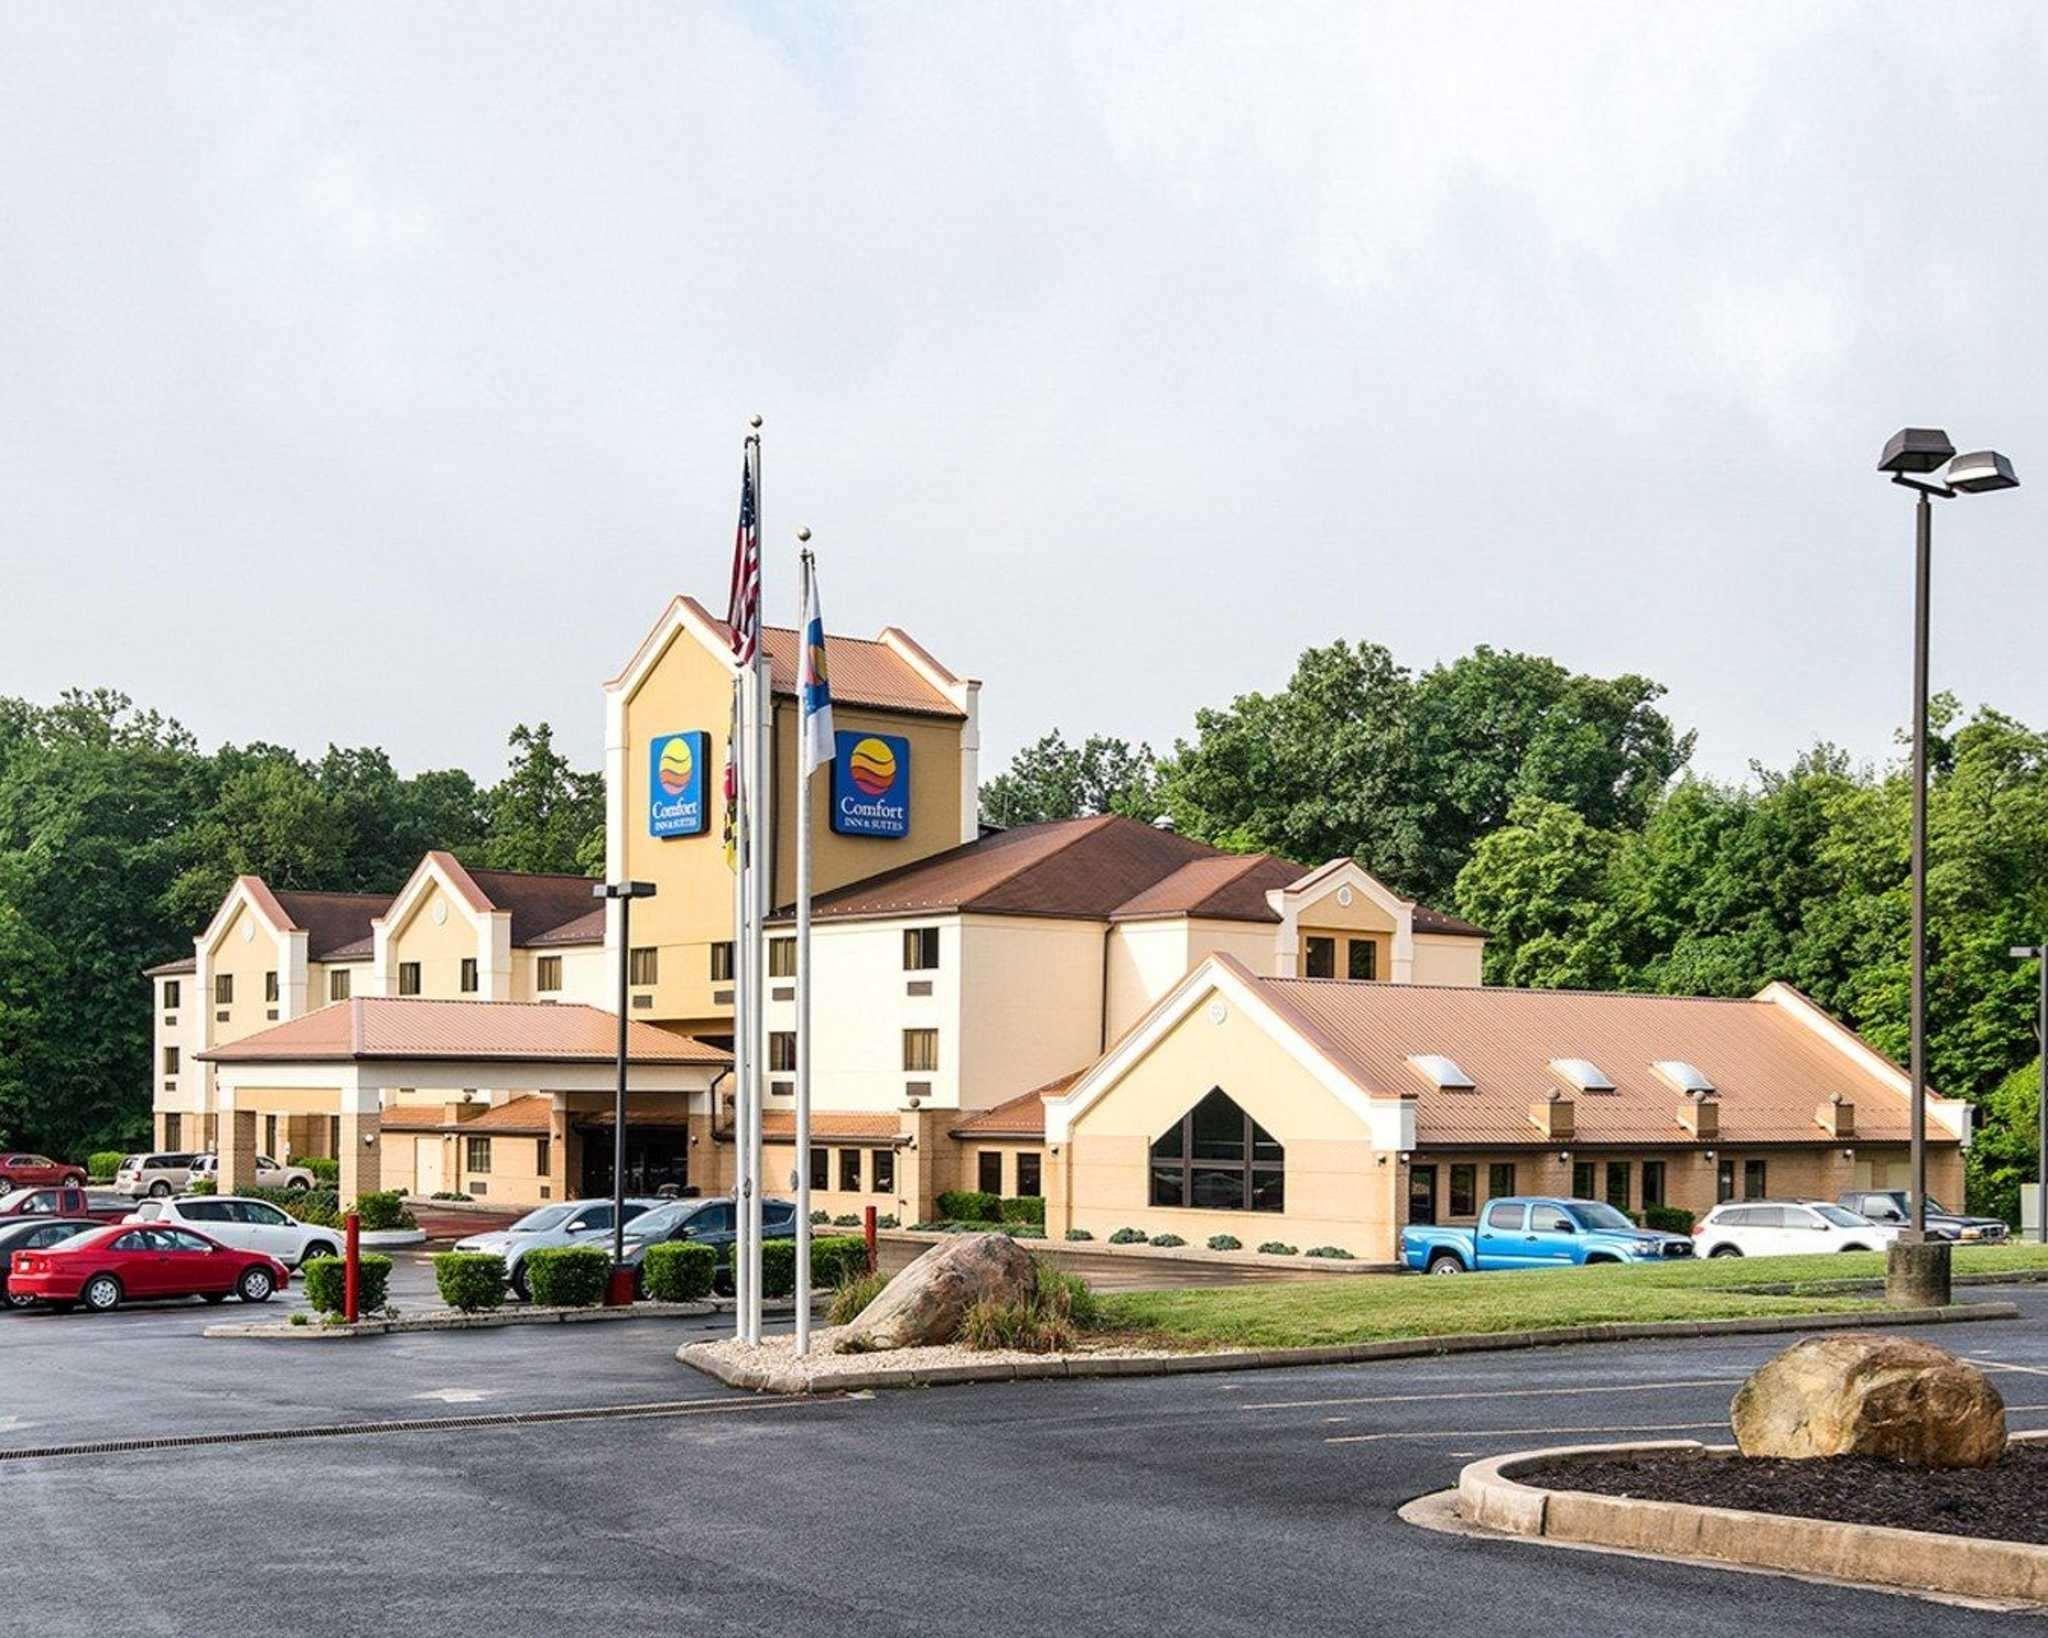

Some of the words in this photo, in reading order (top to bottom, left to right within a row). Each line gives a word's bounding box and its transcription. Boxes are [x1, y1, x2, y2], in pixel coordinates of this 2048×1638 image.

[652, 797, 697, 819] Comfort
[841, 796, 903, 819] Comfort
[845, 817, 862, 827] INN
[871, 820, 903, 830] SUITES
